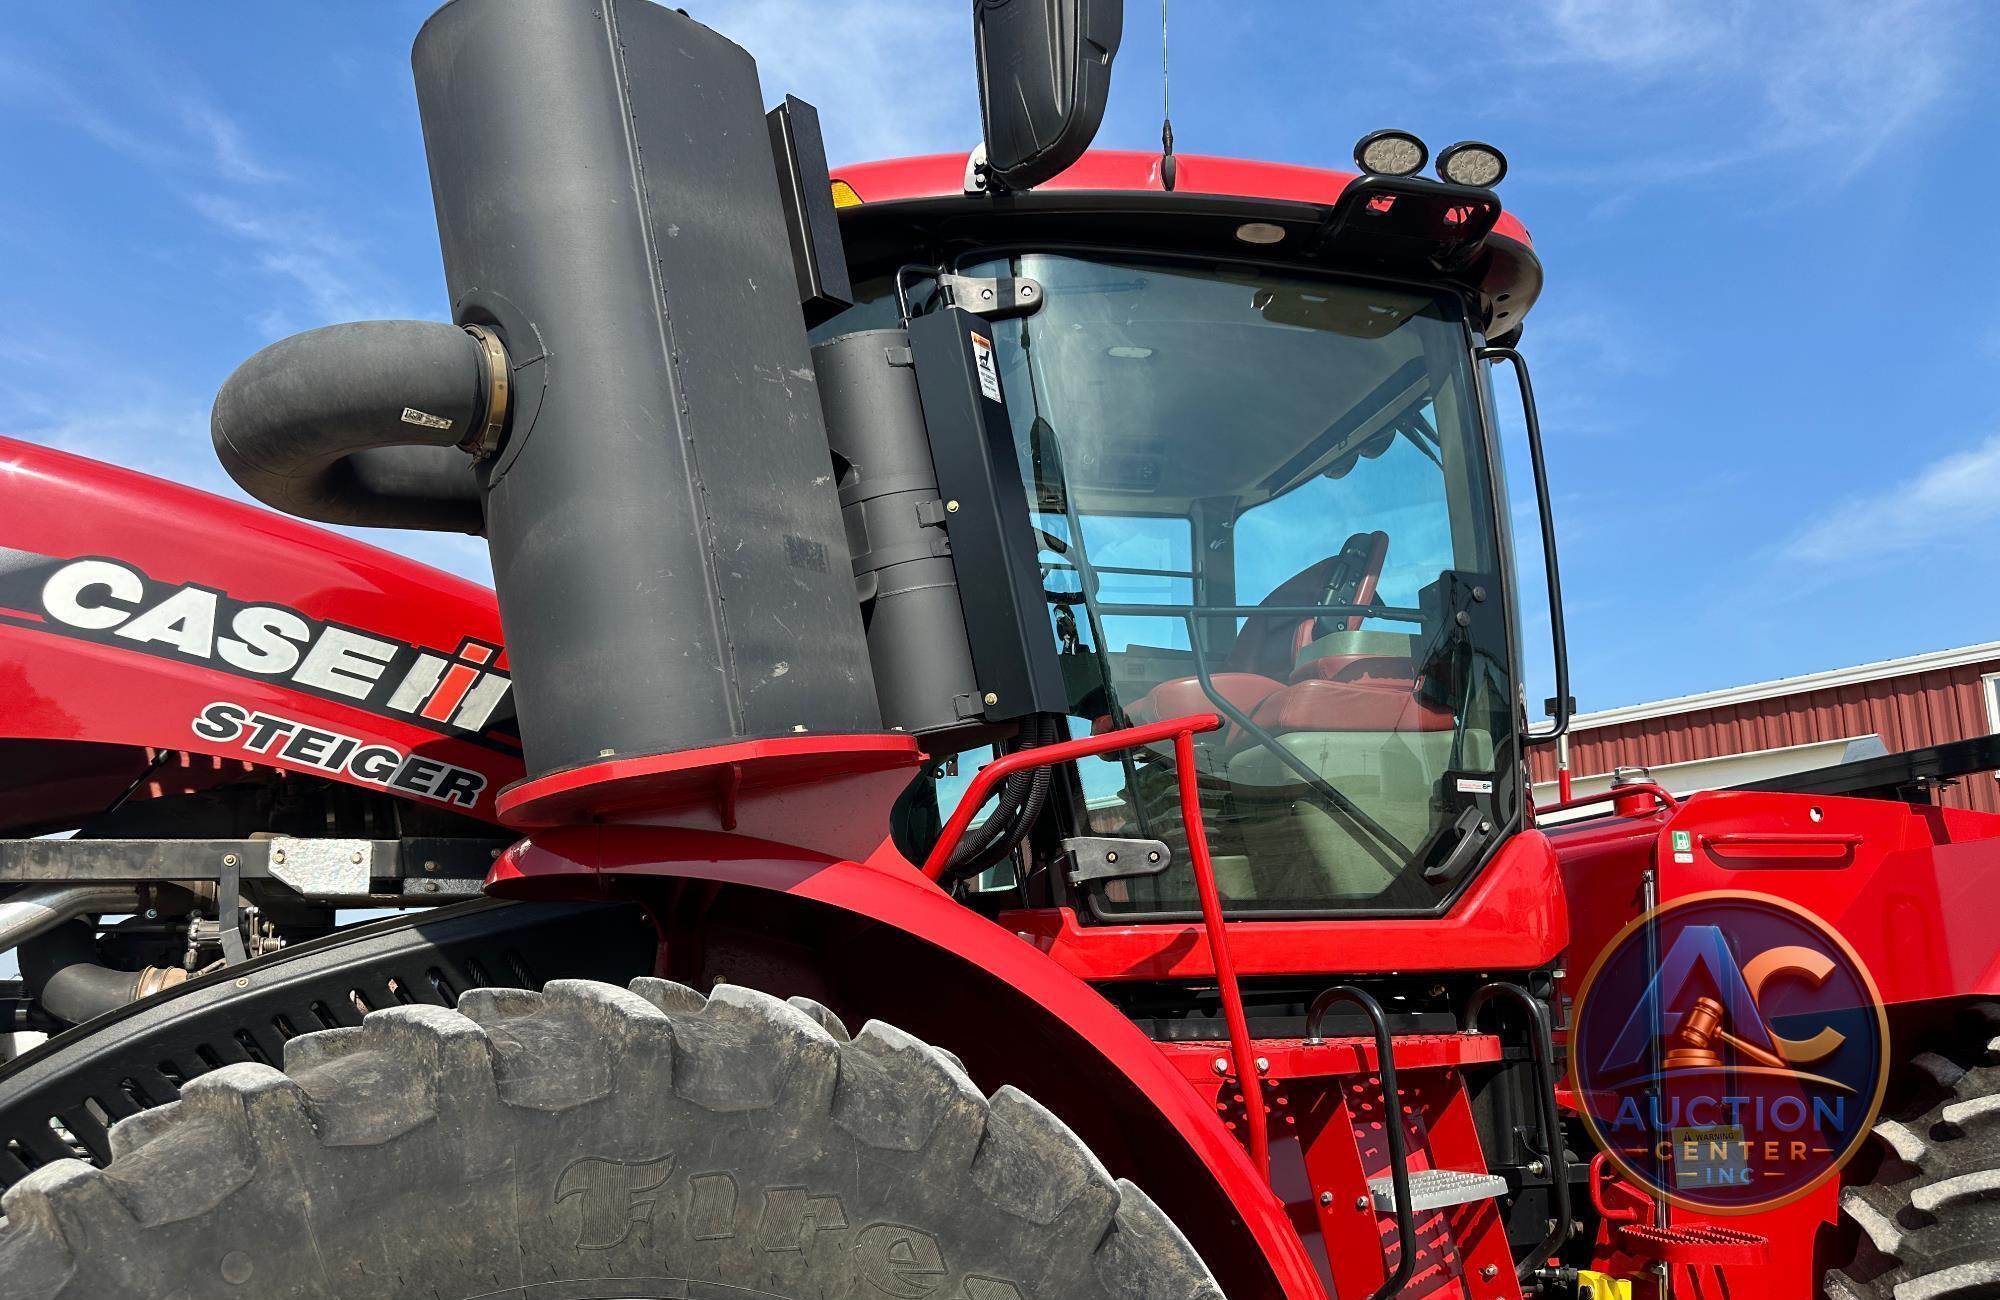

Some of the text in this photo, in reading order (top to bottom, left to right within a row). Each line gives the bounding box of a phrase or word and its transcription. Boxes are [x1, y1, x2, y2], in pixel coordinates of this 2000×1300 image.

[43, 560, 398, 699] CASE
[192, 701, 488, 808] STEIGER
[1695, 1132, 1734, 1141] WARNING
